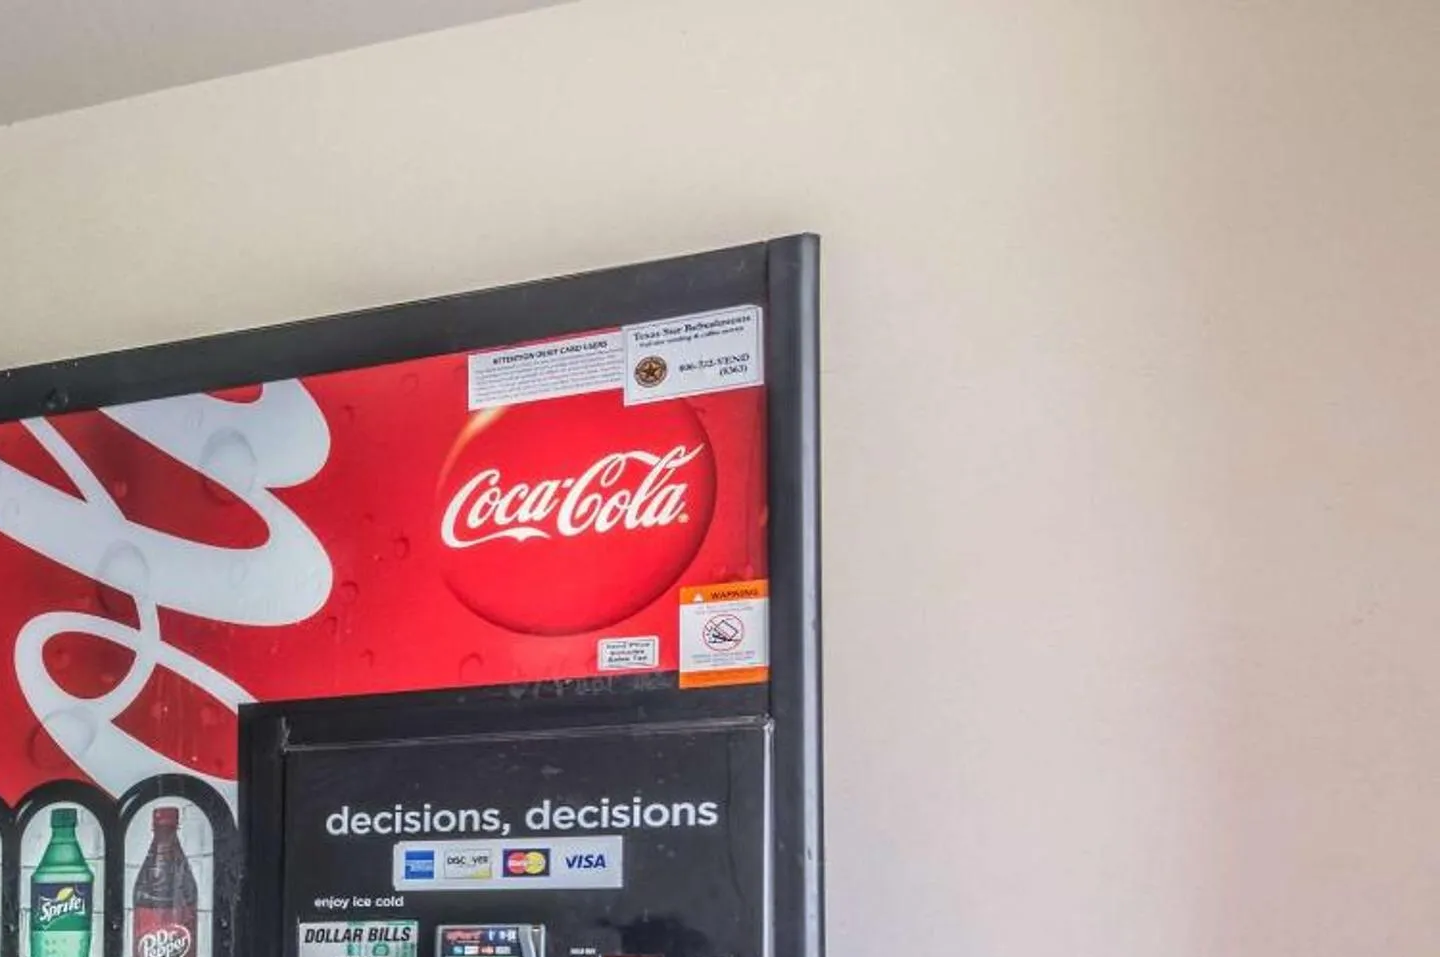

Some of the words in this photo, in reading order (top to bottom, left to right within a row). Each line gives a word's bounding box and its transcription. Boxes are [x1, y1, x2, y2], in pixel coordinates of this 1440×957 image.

[560, 344, 582, 355] CARD
[583, 340, 608, 350] USERS
[441, 443, 704, 548] Coca-Cola
[710, 588, 759, 600] WARNING
[325, 803, 512, 836] decisions,
[524, 797, 719, 832] decisions
[565, 853, 607, 869] VISA
[39, 896, 82, 922] Sprite
[314, 896, 351, 909] enjoy
[352, 895, 372, 907] ice
[375, 896, 404, 908] cold
[155, 928, 176, 946] Dr
[304, 928, 363, 943] DOLLAR
[367, 926, 412, 942] BILLS
